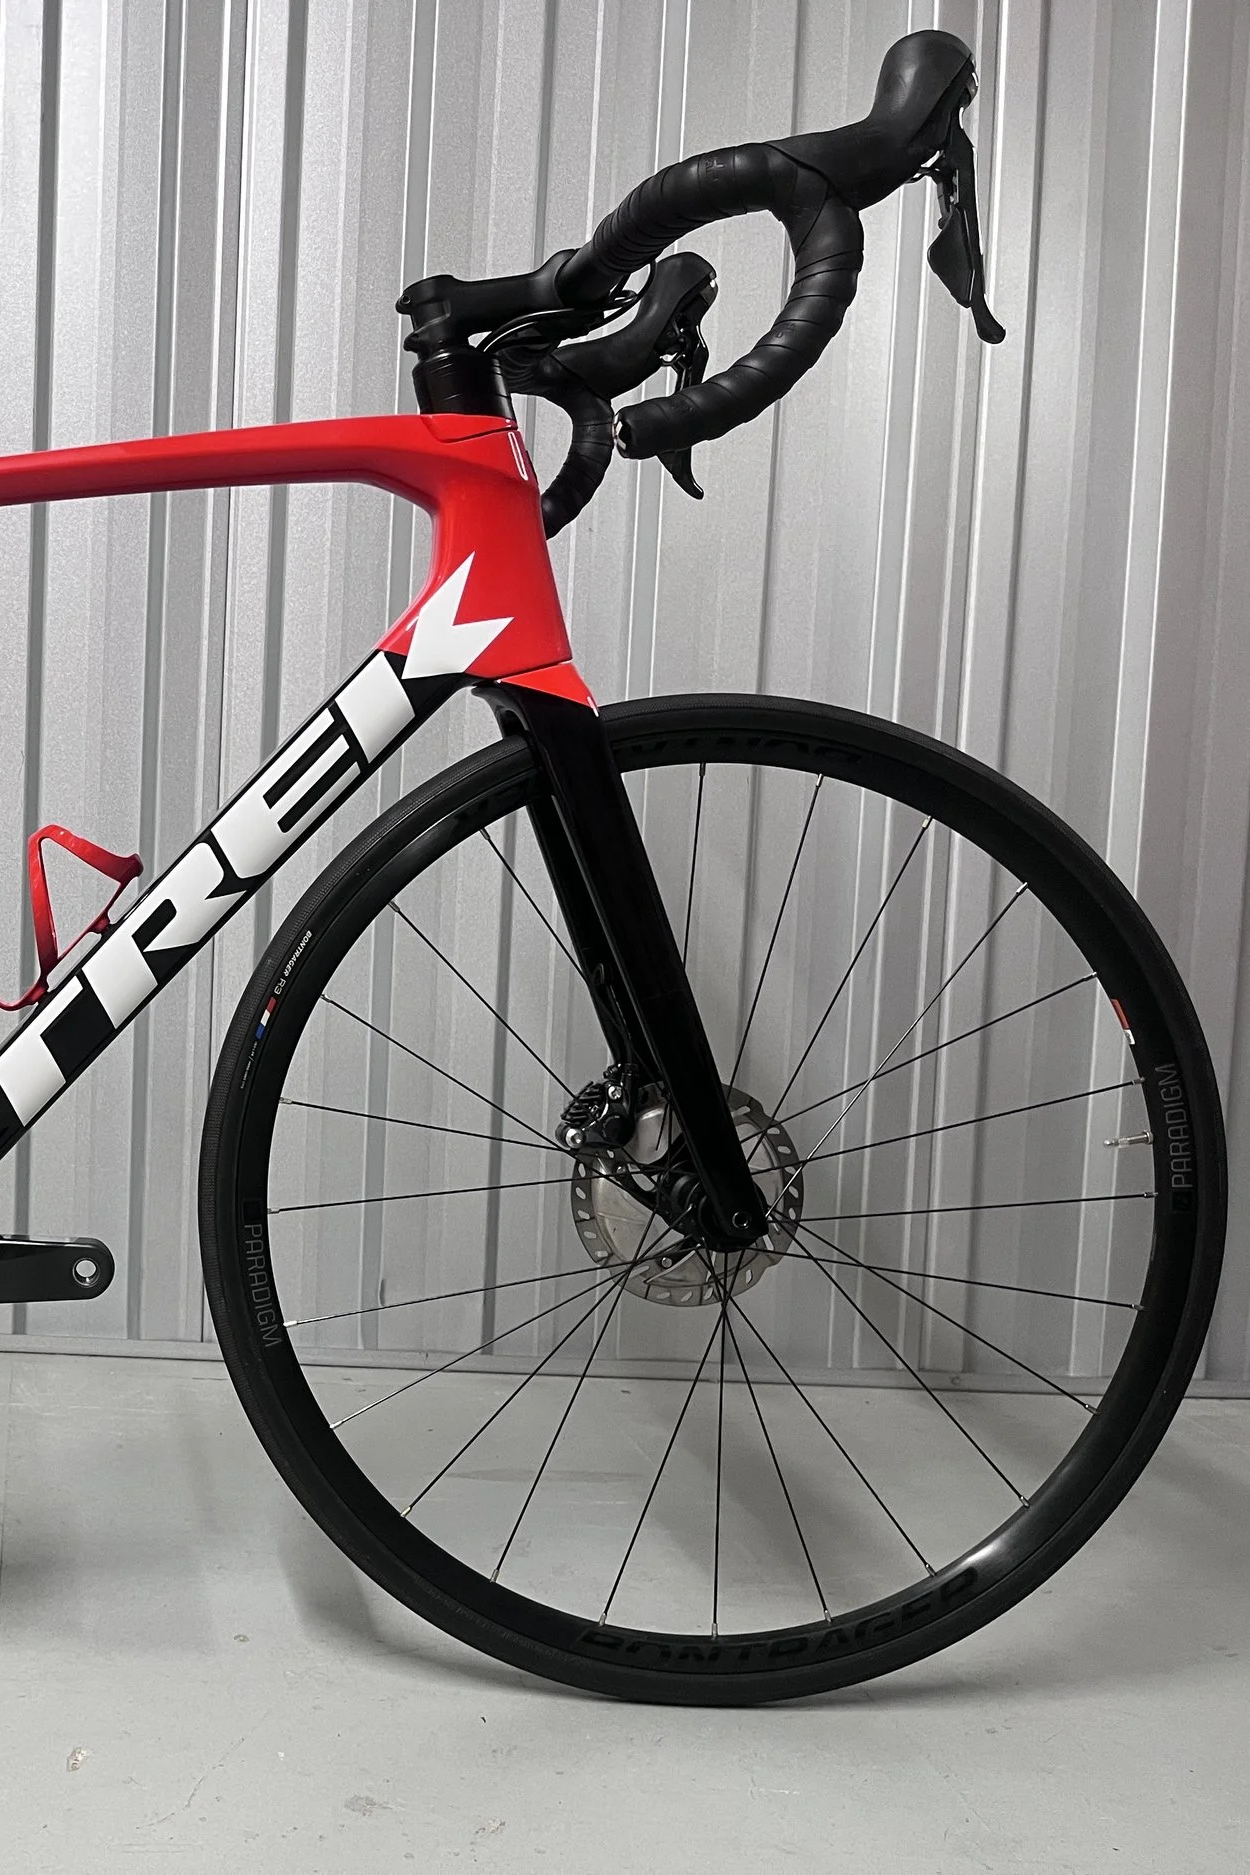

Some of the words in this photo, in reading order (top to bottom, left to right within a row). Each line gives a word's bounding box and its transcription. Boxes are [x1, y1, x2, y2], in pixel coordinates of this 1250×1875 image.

[273, 978, 287, 995] R3
[284, 930, 312, 977] BONTRAGER
[1155, 1063, 1194, 1189] PARADIGM
[243, 1223, 284, 1347] PARADIGM
